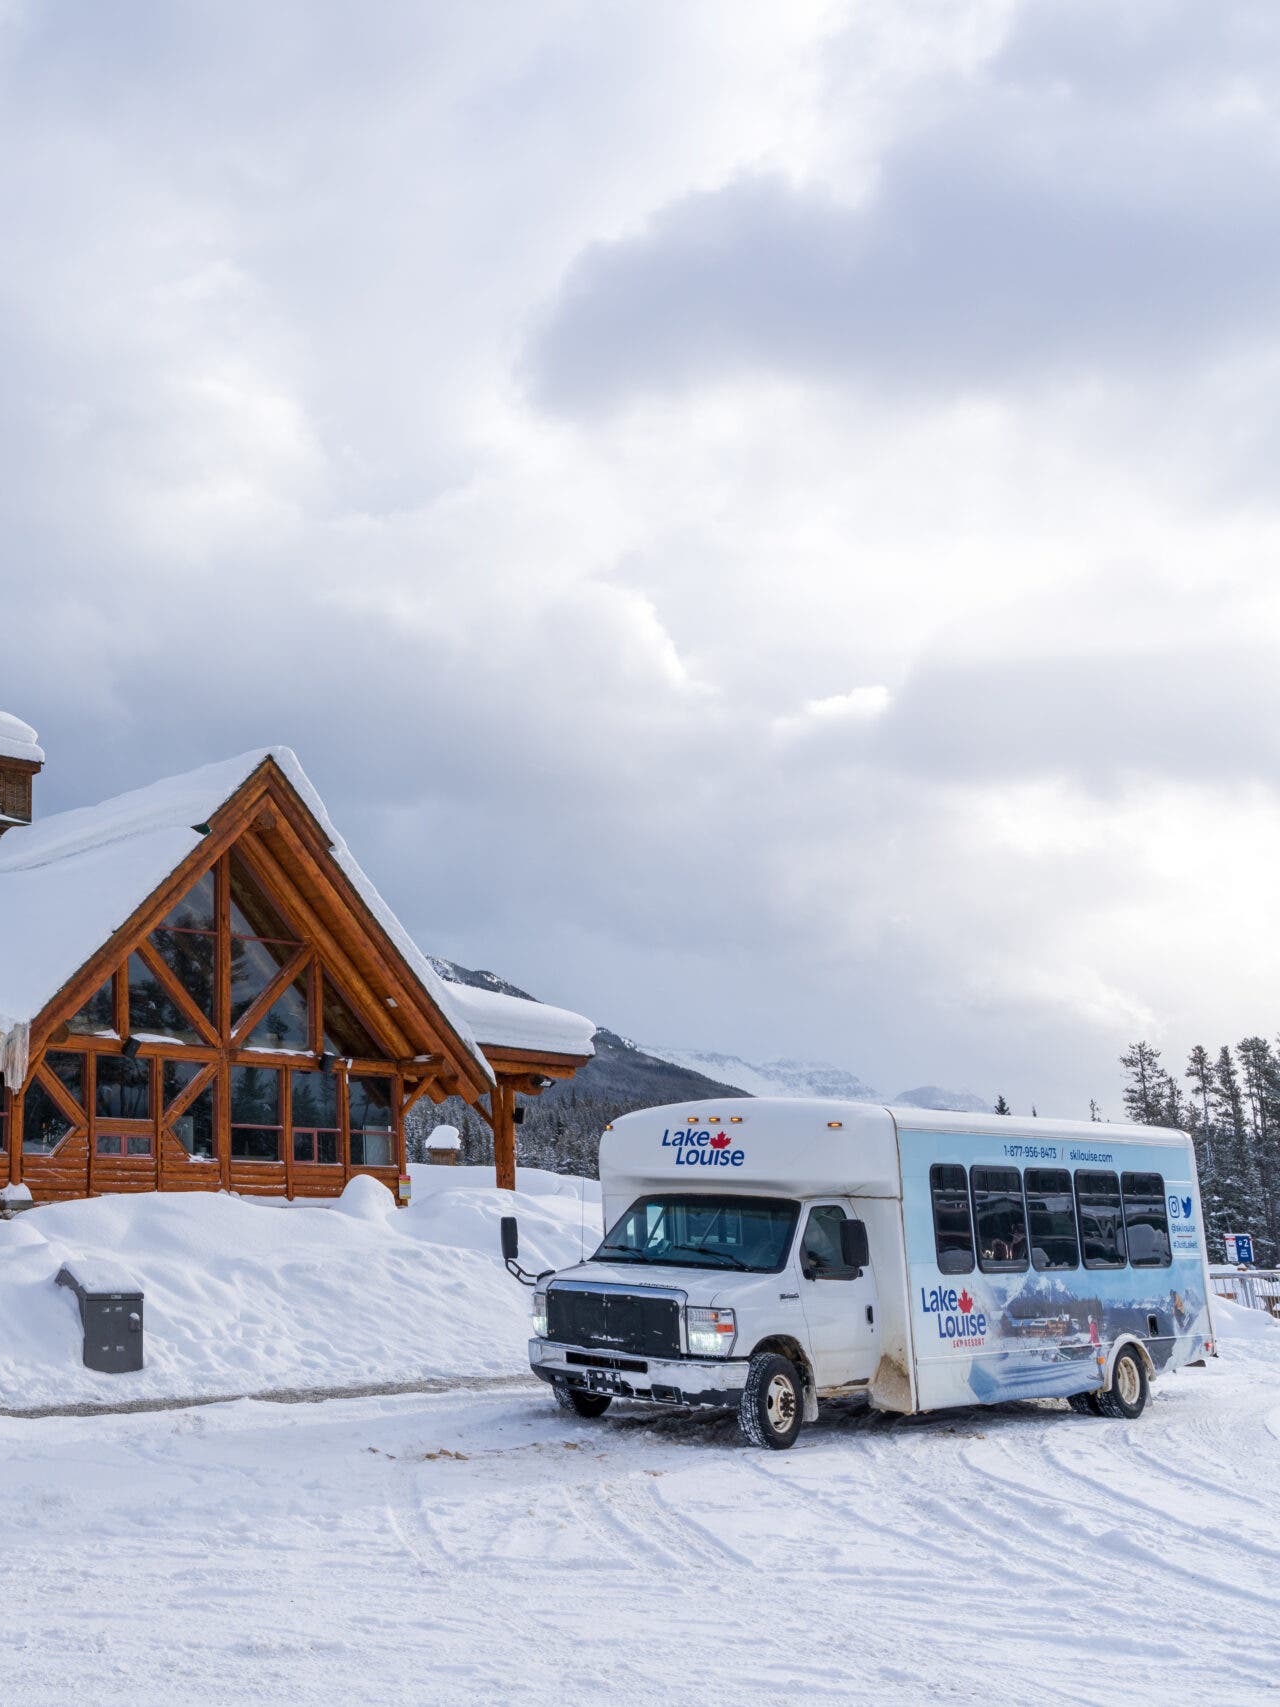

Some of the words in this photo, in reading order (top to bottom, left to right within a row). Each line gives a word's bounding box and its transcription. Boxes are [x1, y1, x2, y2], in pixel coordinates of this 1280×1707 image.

[662, 1128, 710, 1147] Lake
[676, 1147, 745, 1167] Louise
[921, 1286, 958, 1312] Lake
[937, 1313, 986, 1338] Louise
